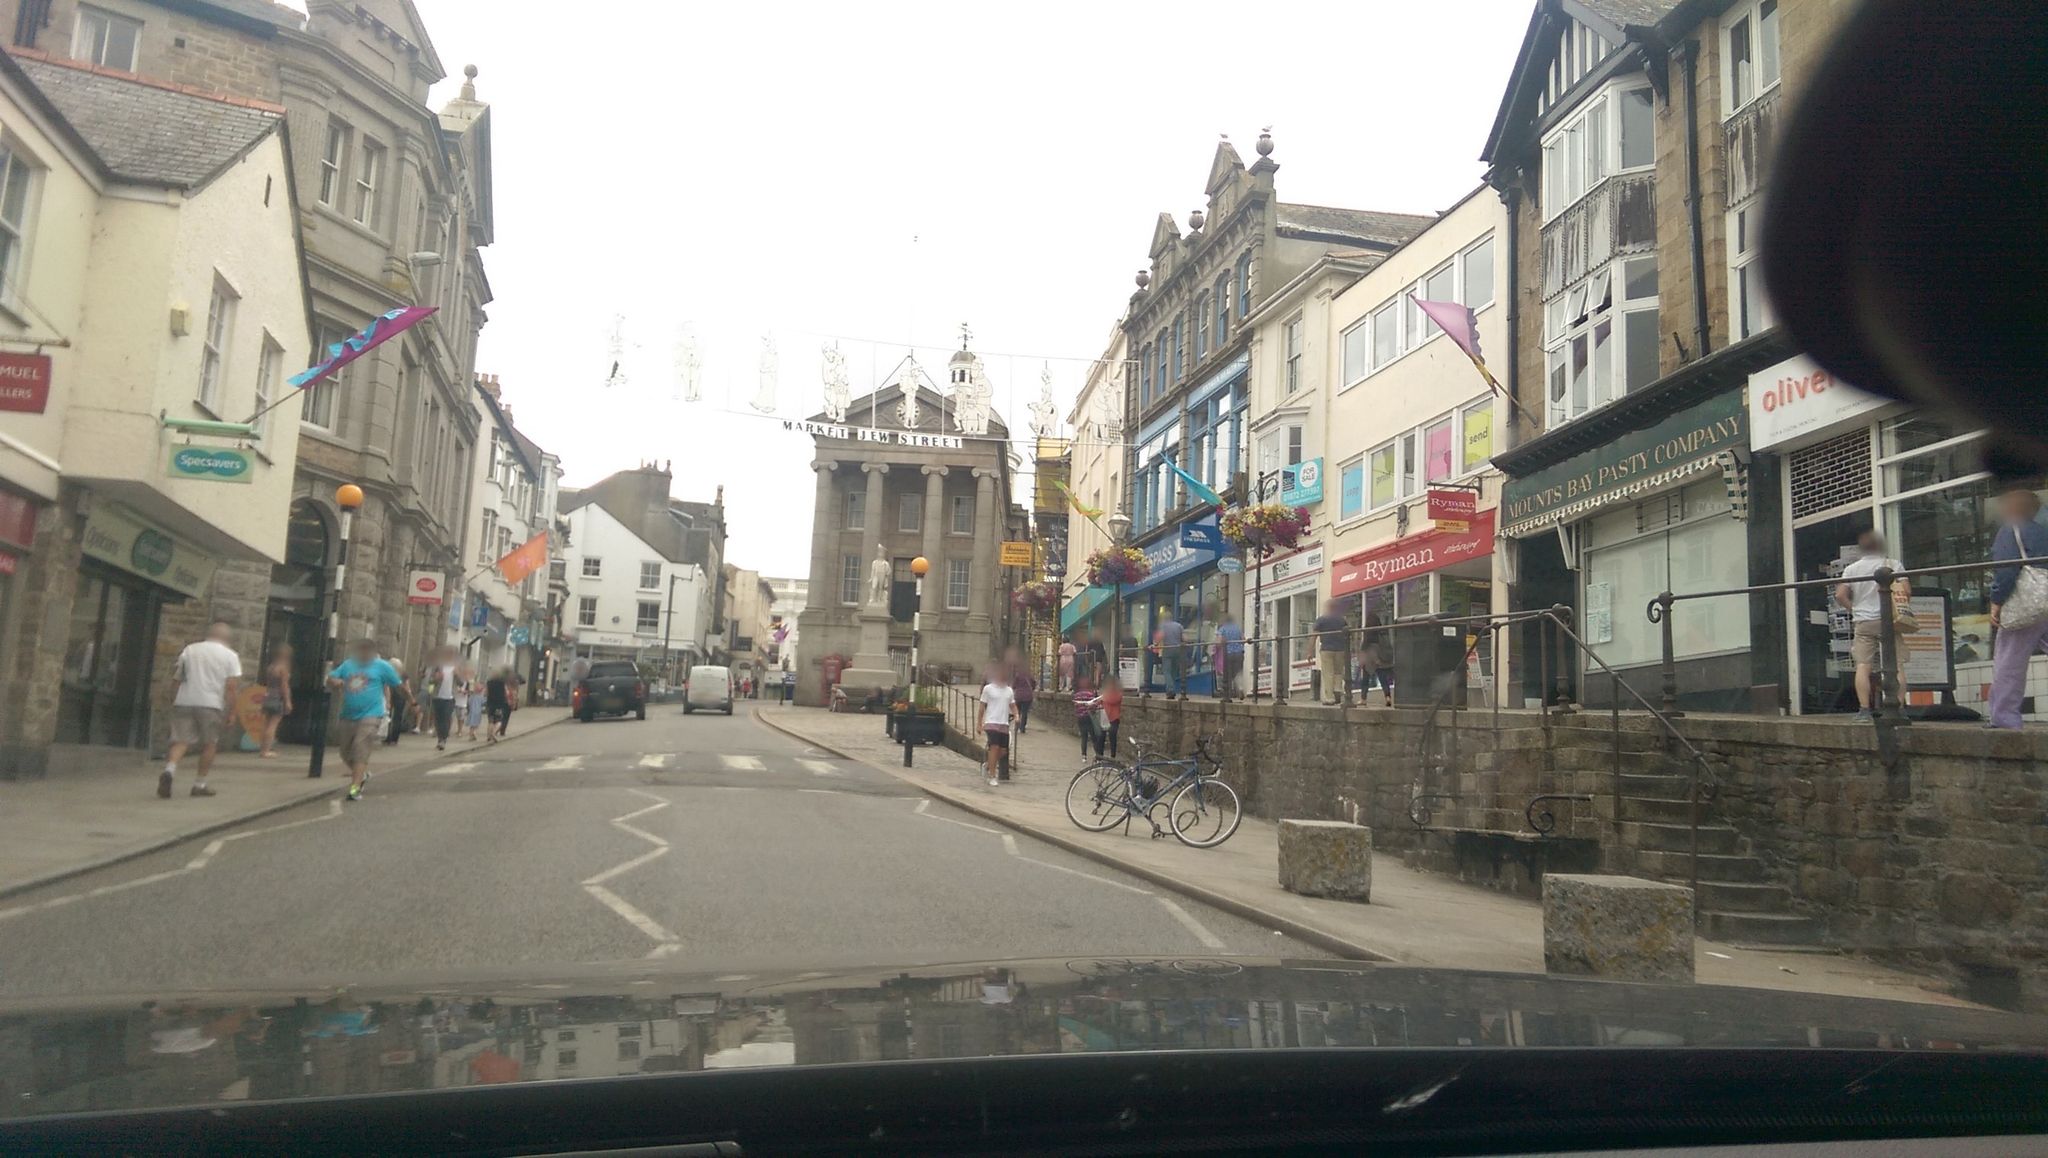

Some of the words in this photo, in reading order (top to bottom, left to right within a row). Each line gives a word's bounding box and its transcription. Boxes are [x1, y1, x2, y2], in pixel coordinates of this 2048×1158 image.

[783, 420, 847, 437] MARKET
[860, 431, 889, 443] JEW
[901, 434, 960, 448] STREET
[1469, 427, 1488, 444] send
[181, 454, 240, 469] Specsavers
[1509, 485, 1561, 518] MOUNTS
[1568, 473, 1594, 498] BAY
[1598, 449, 1649, 486] PASTY
[1654, 414, 1742, 464] COMPANY
[1302, 472, 1315, 482] SALE
[1303, 466, 1314, 475] FOR
[1431, 497, 1475, 508] Ryman
[1364, 548, 1434, 580] Ryman
